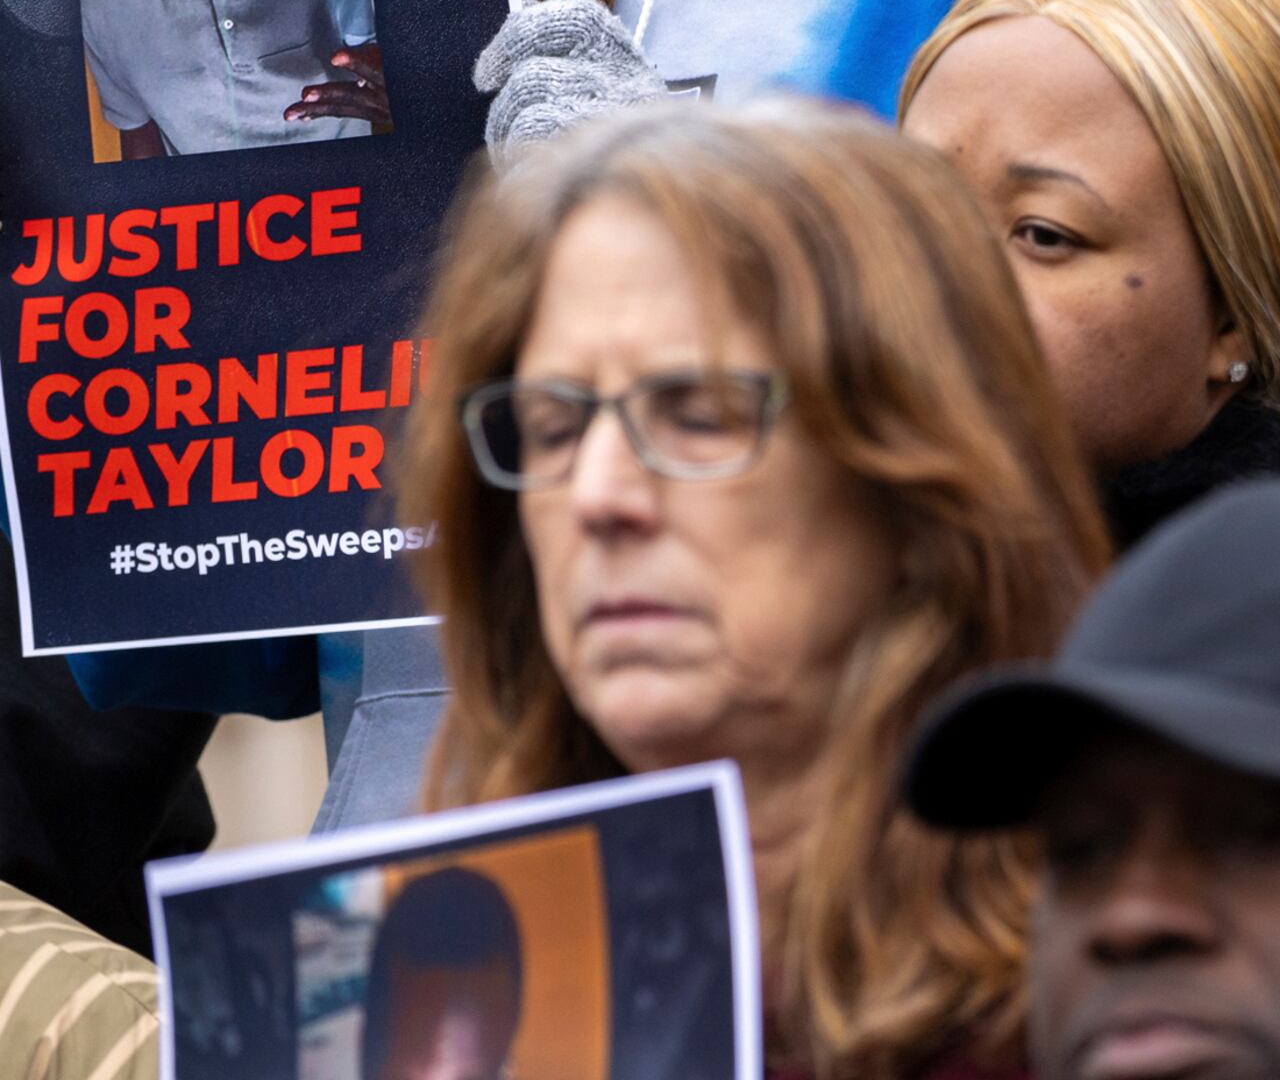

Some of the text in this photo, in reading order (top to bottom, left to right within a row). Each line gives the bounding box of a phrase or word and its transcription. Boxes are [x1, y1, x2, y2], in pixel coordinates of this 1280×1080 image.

[12, 187, 362, 286] JUSTICE
[19, 286, 191, 363] FOR
[37, 424, 385, 517] TAYLOR
